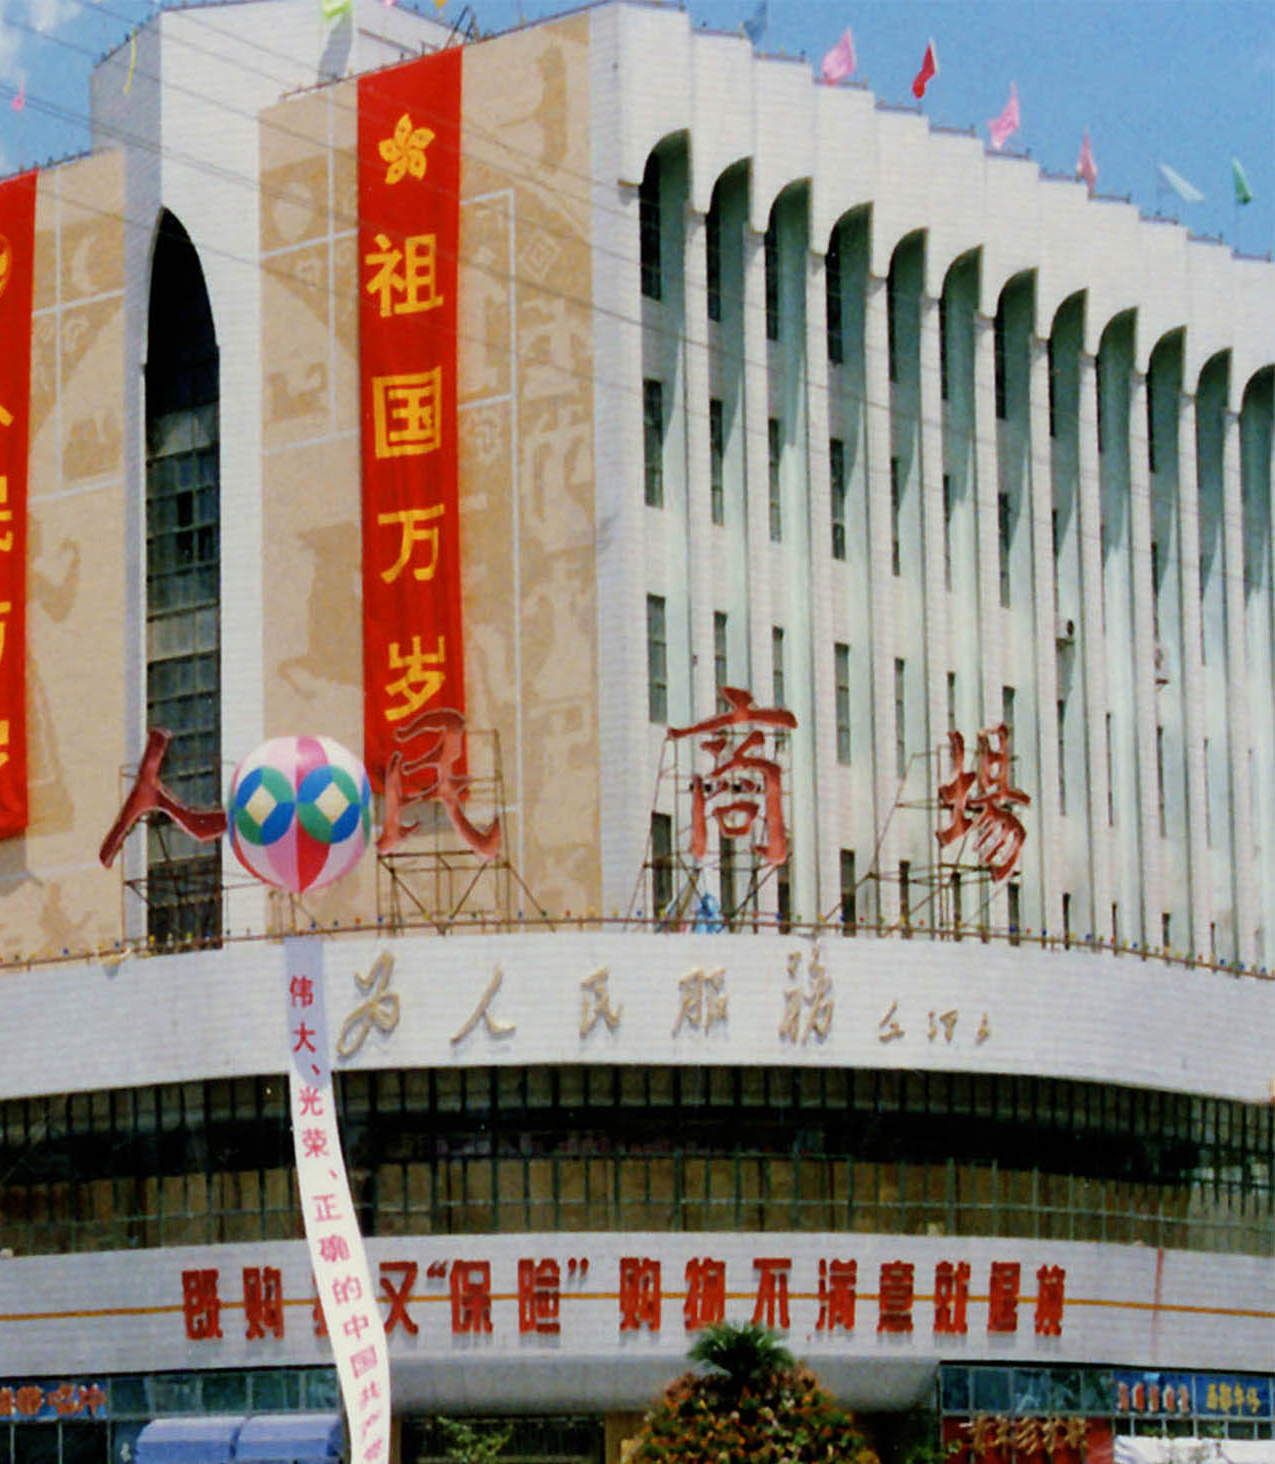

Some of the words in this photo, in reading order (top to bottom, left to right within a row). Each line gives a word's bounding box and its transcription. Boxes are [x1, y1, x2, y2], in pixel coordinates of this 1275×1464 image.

[364, 233, 446, 721] 祖国万岁
[181, 1257, 1065, 1340] 既购又“保险”购物不满意就退换
